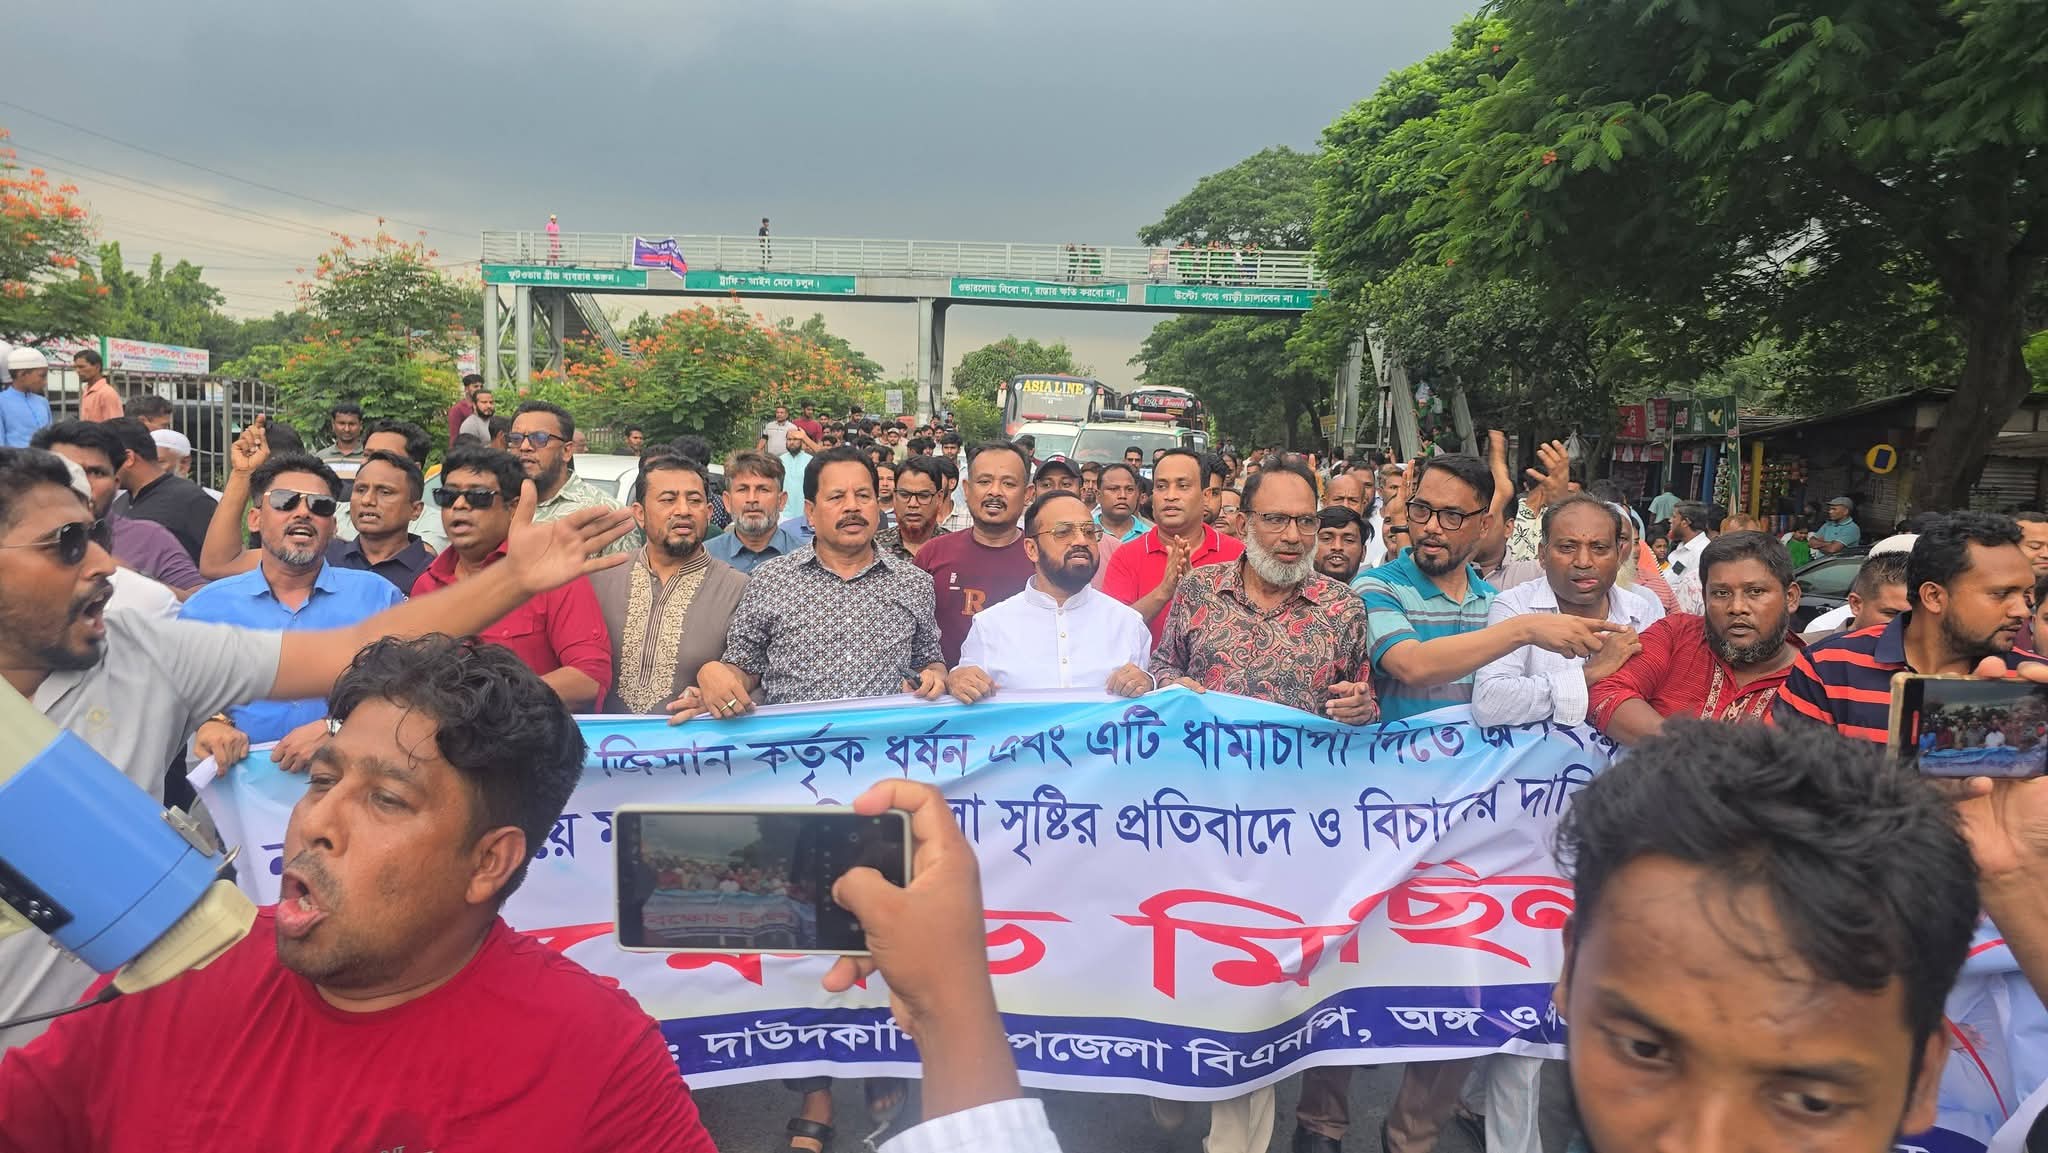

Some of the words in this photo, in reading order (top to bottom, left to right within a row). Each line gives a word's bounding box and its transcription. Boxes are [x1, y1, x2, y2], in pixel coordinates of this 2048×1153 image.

[748, 275, 770, 287] আইন
[1023, 379, 1053, 393] ASIA
[1054, 381, 1084, 395] LINE
[594, 734, 737, 777] জিসান
[746, 722, 872, 798] কর্তৃক
[886, 720, 976, 778] ধর্ষন
[988, 724, 1073, 767] এবং
[1086, 705, 1167, 766] এটি
[1183, 715, 1361, 772] ধামাচাপা
[1369, 720, 1470, 764] দিতে
[995, 783, 1103, 866] সৃষ্টির
[1115, 787, 1297, 858] প্রতিবাদে
[1308, 807, 1343, 849] ও
[1386, 1006, 1487, 1038] অঙ্গ
[1499, 1005, 1541, 1030] ও
